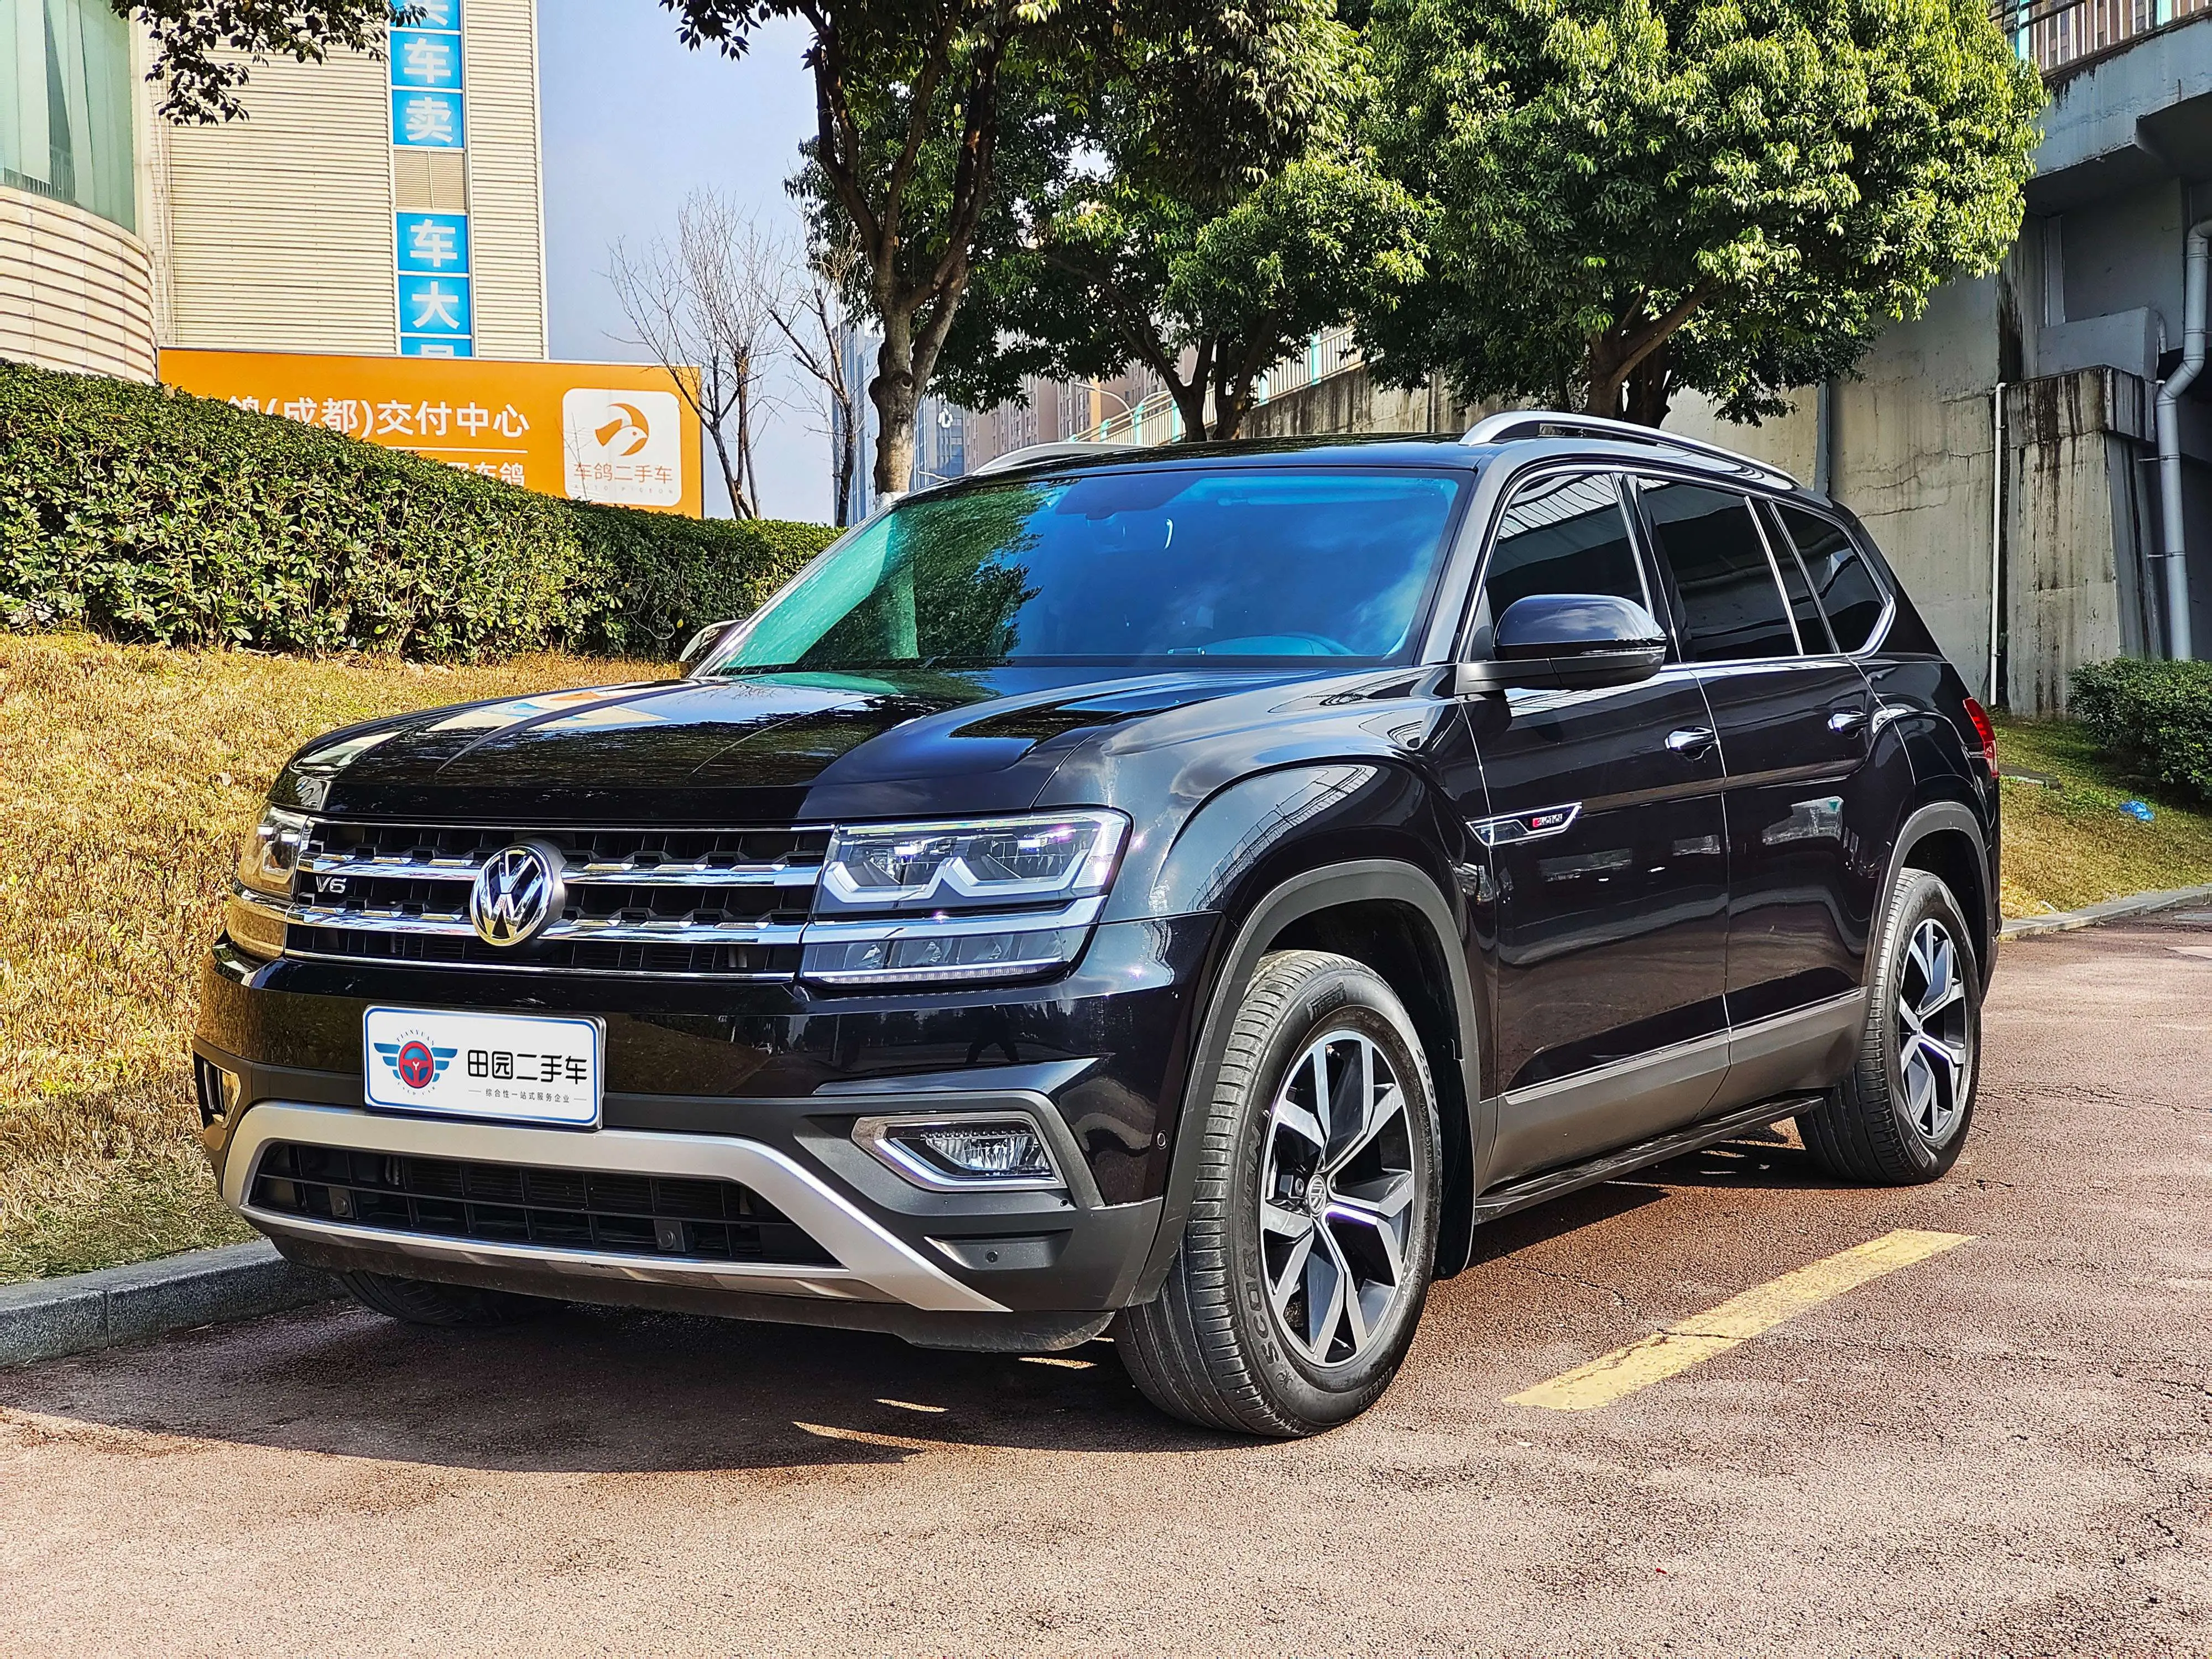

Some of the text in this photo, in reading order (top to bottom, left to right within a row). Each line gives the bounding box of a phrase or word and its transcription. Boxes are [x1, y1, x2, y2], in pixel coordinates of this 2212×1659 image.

[574, 462, 672, 484] 车鸽二手车
[315, 875, 347, 894] V6
[467, 1049, 587, 1085] 田园二手车
[486, 1088, 570, 1103] 综合性一站式服务企业
